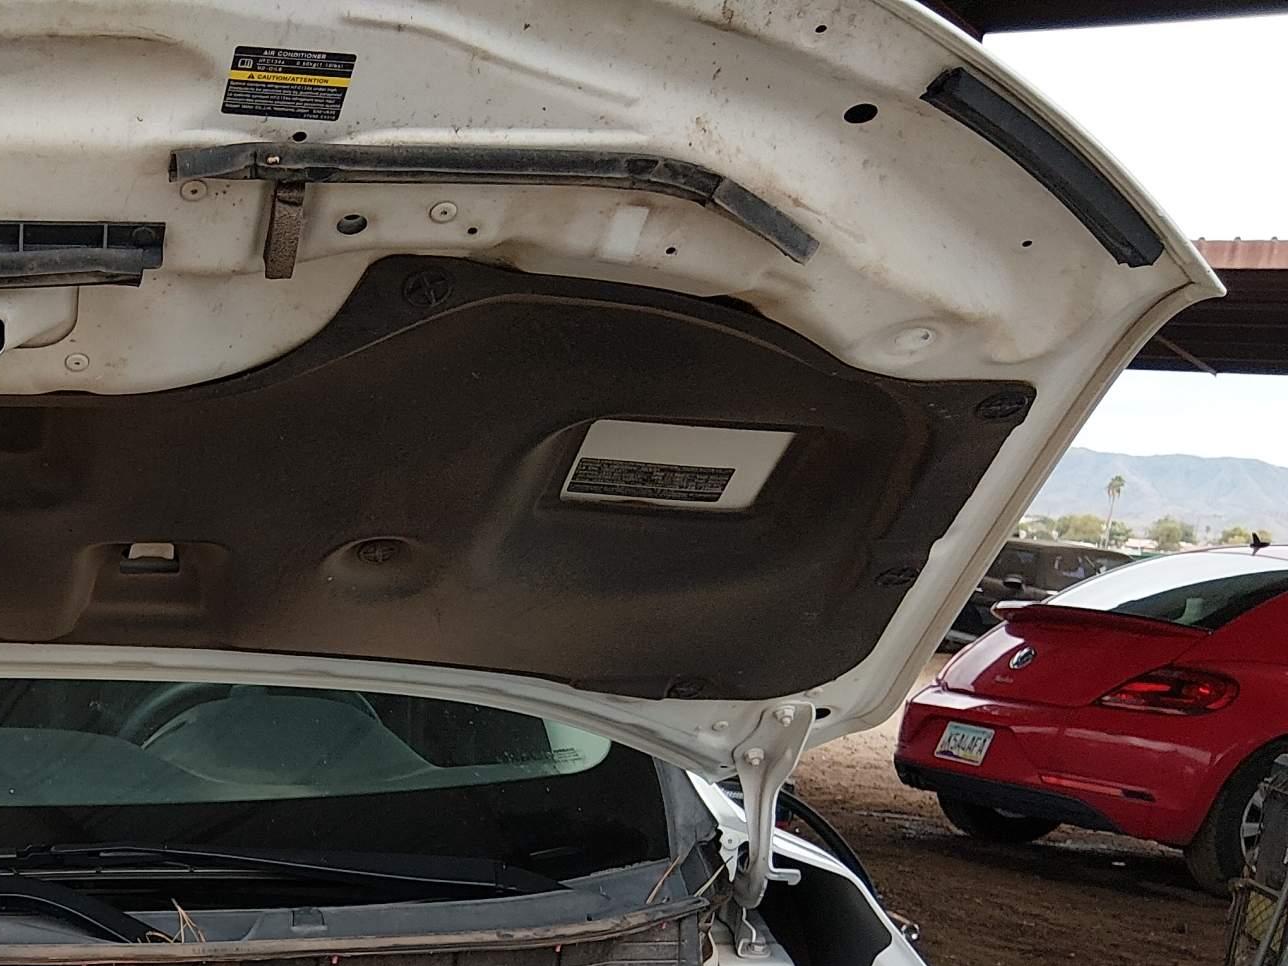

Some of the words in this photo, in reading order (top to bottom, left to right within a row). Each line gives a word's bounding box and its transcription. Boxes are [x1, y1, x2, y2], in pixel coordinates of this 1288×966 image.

[263, 49, 275, 57] AIR
[277, 50, 327, 60] CONDITIONER
[257, 74, 329, 85] CAUTION/ATTENTION
